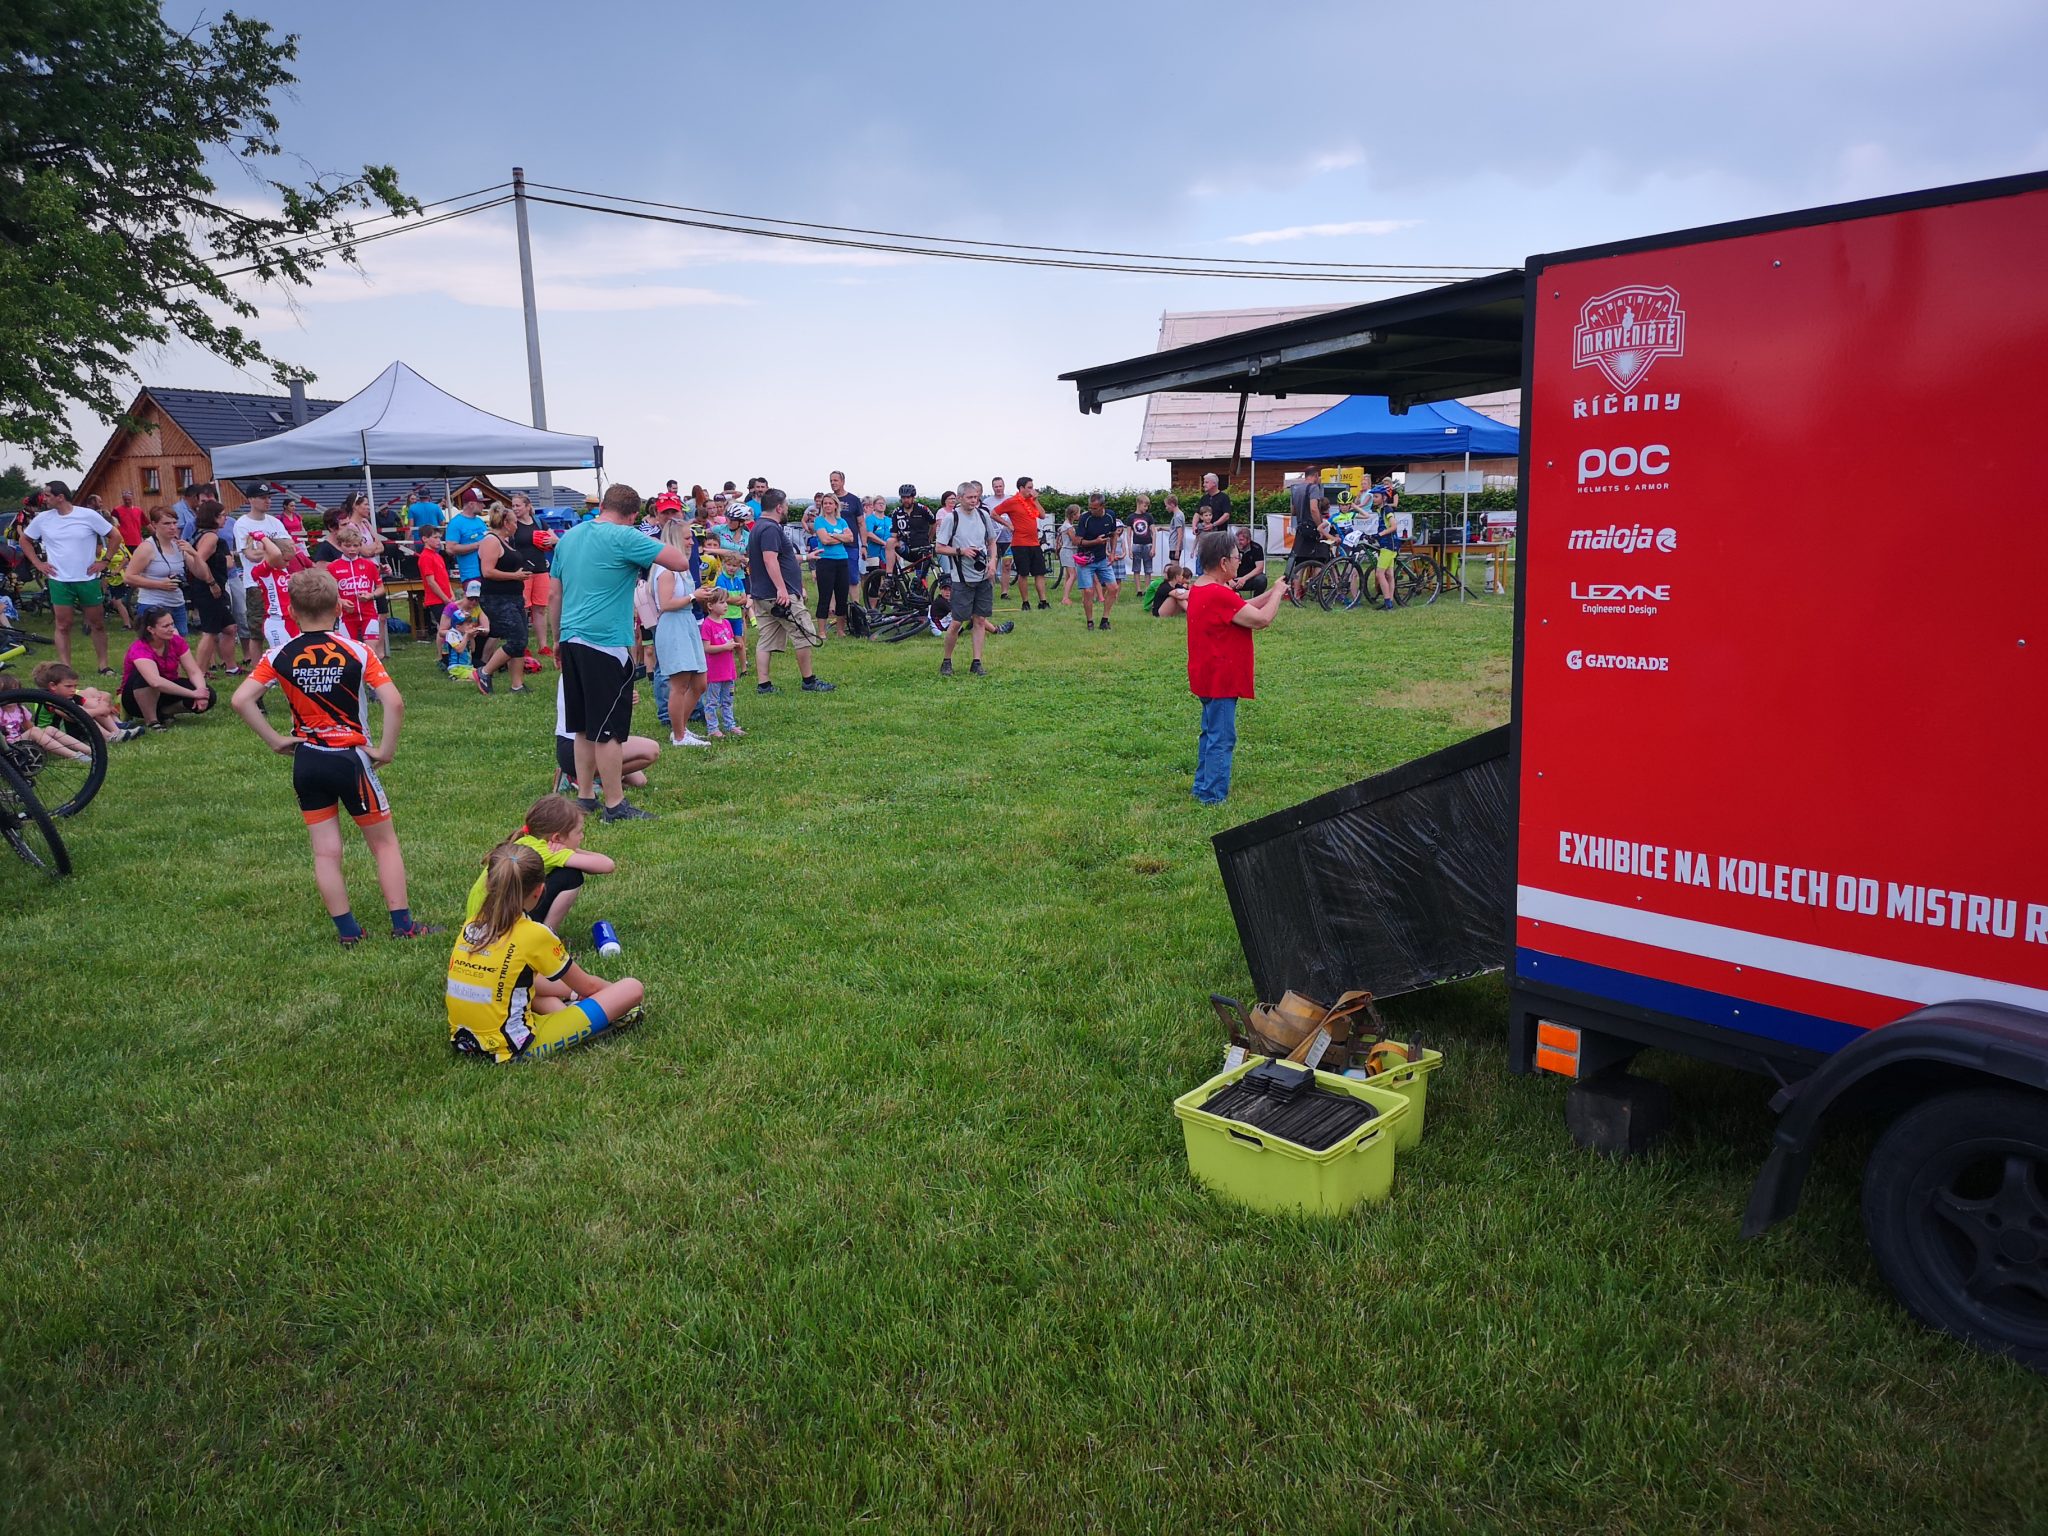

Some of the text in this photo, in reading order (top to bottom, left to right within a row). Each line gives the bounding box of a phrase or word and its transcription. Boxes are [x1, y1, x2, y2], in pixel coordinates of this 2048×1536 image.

[1577, 485, 1620, 493] HELMETS
[1634, 482, 1669, 491] ARMOR
[1567, 523, 1654, 554] maloja
[1570, 581, 1671, 601] LEZYNE
[1582, 603, 1658, 617] Engineered Design
[1585, 654, 1669, 671] GATORADE
[292, 666, 344, 678] PRESTIGE
[297, 675, 341, 686] CYCLING
[303, 684, 332, 694] TEAM
[1559, 830, 1669, 881] EXHIBICE
[1674, 849, 1711, 888] NA
[1718, 856, 1829, 908] KOLECH
[1835, 874, 1879, 916] OD
[1886, 881, 2017, 938] MISTRU
[454, 959, 497, 973] APACHE
[496, 942, 516, 1002] LOKO TRUTNOV
